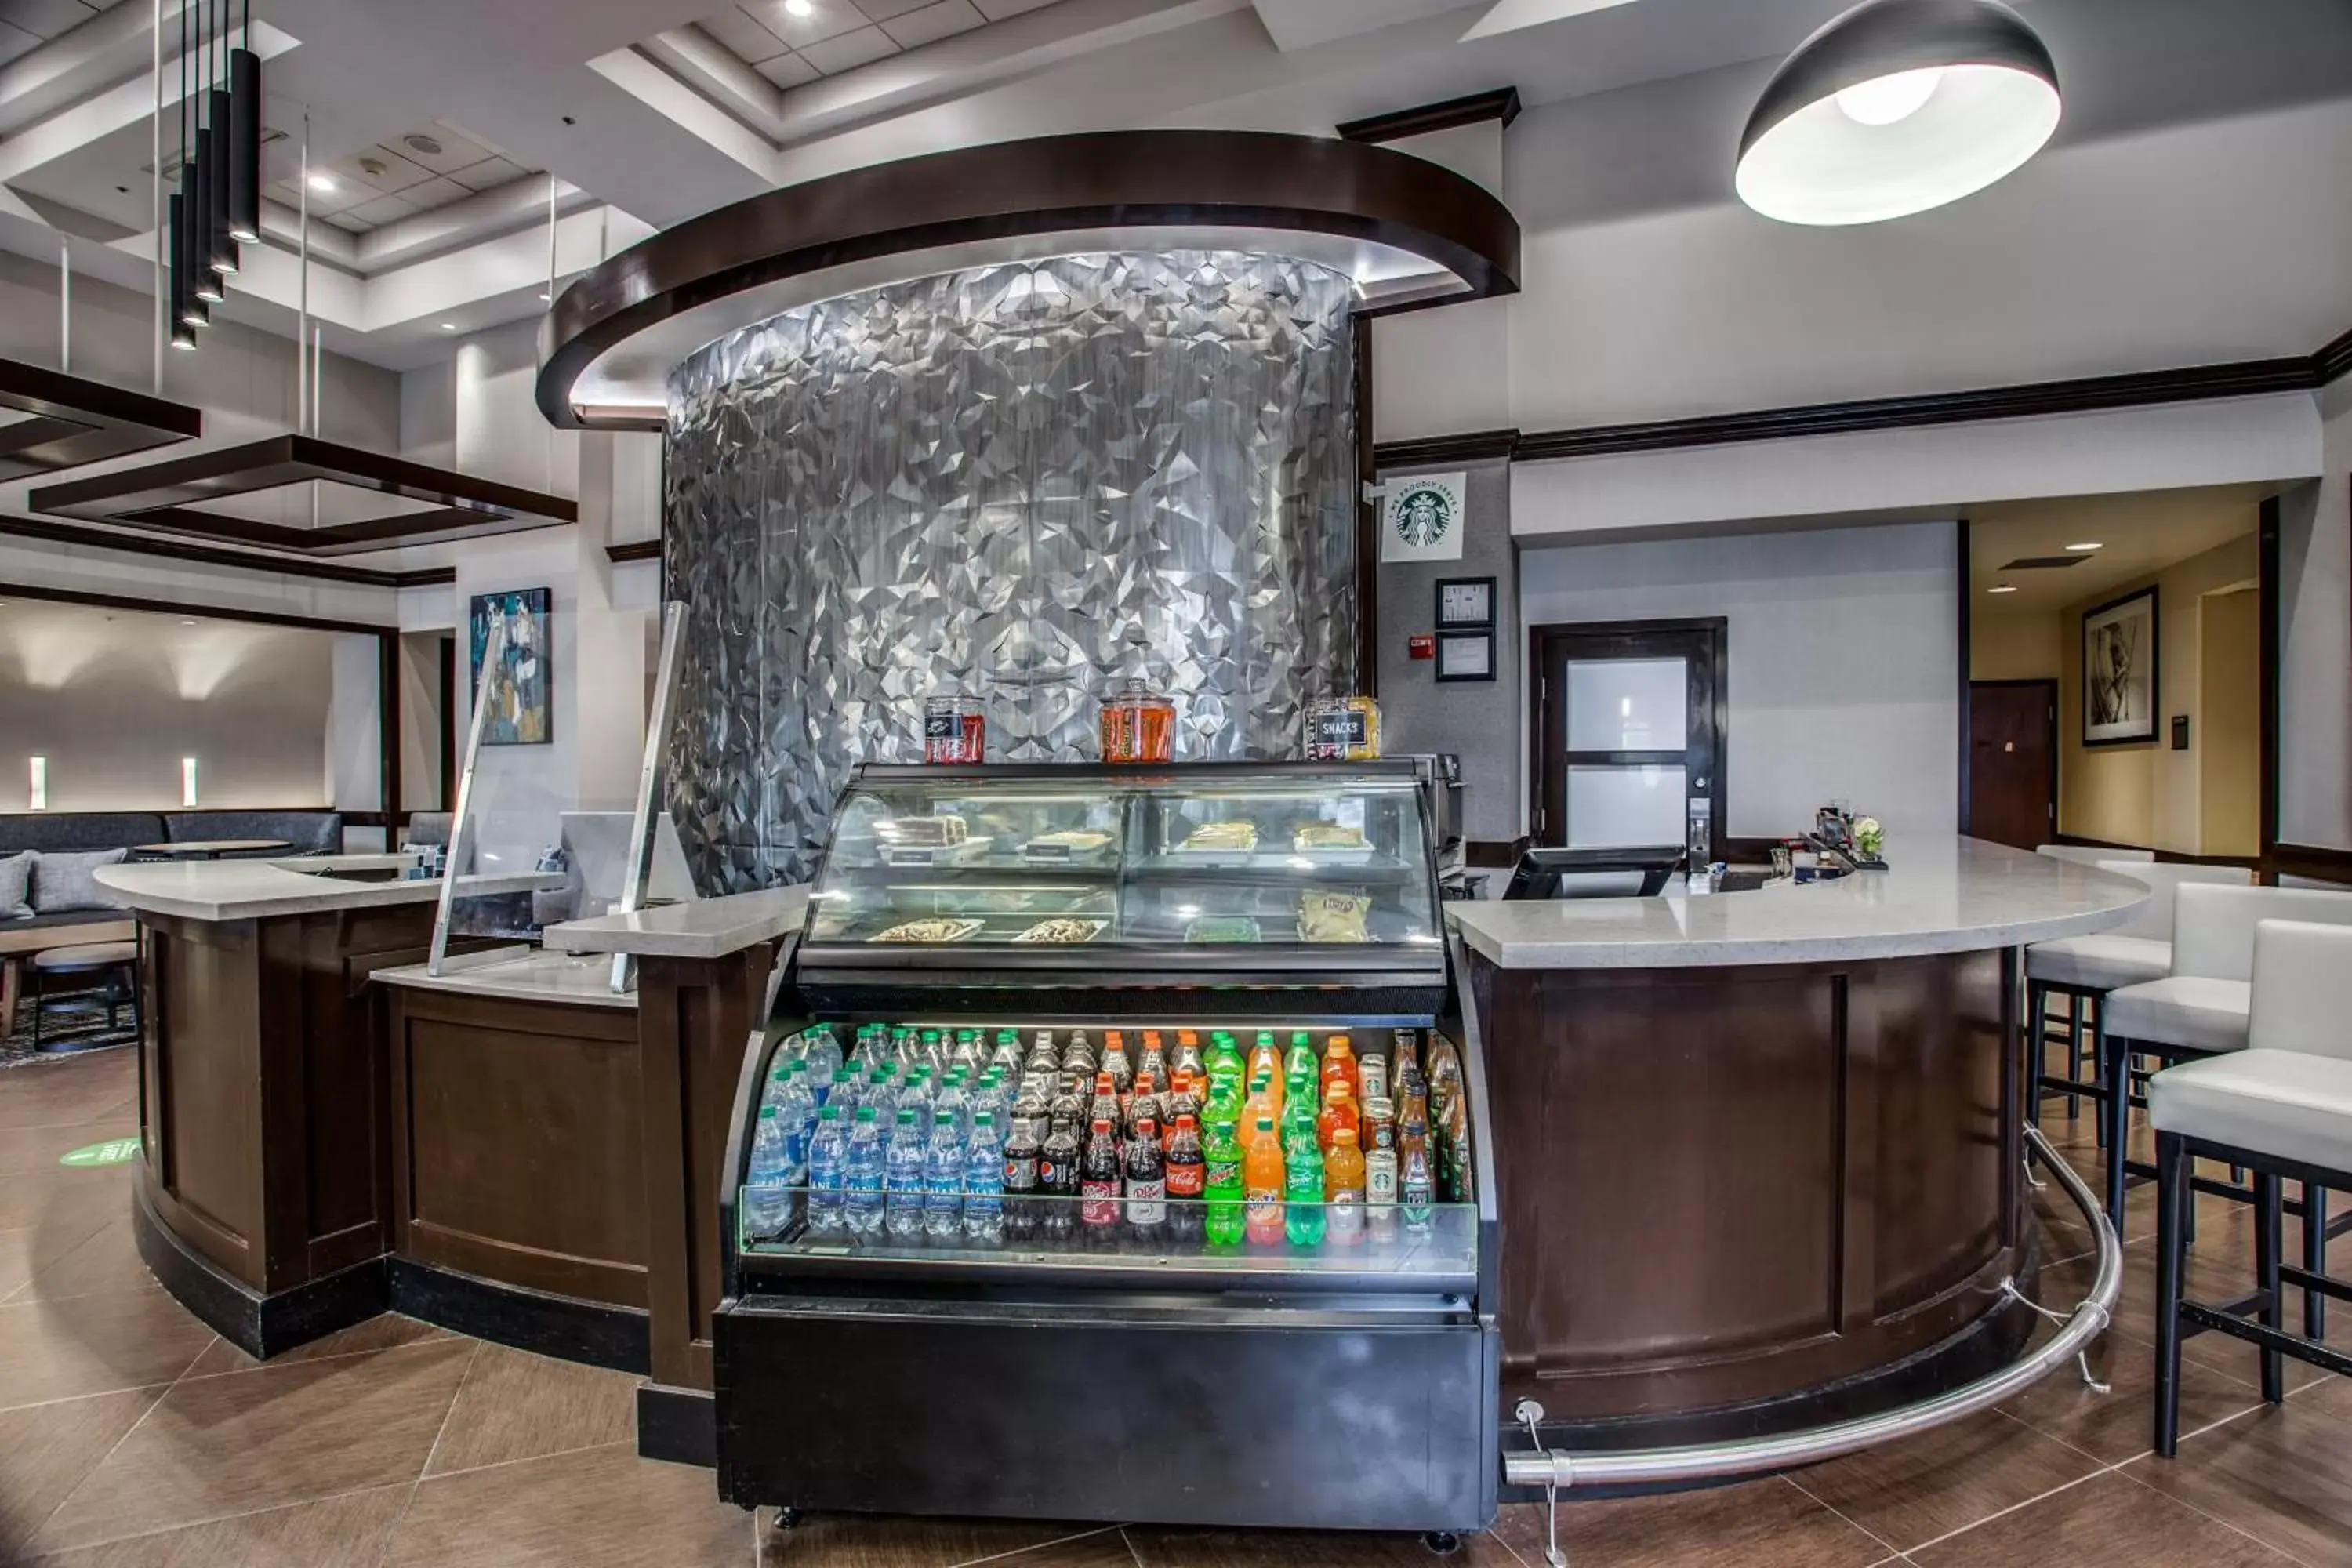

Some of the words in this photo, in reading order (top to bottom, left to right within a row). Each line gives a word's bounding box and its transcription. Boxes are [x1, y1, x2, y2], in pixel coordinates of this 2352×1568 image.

[1399, 480, 1436, 497] PROUDLY
[1438, 483, 1457, 505] SERVE
[1322, 721, 1359, 735] SNACKS
